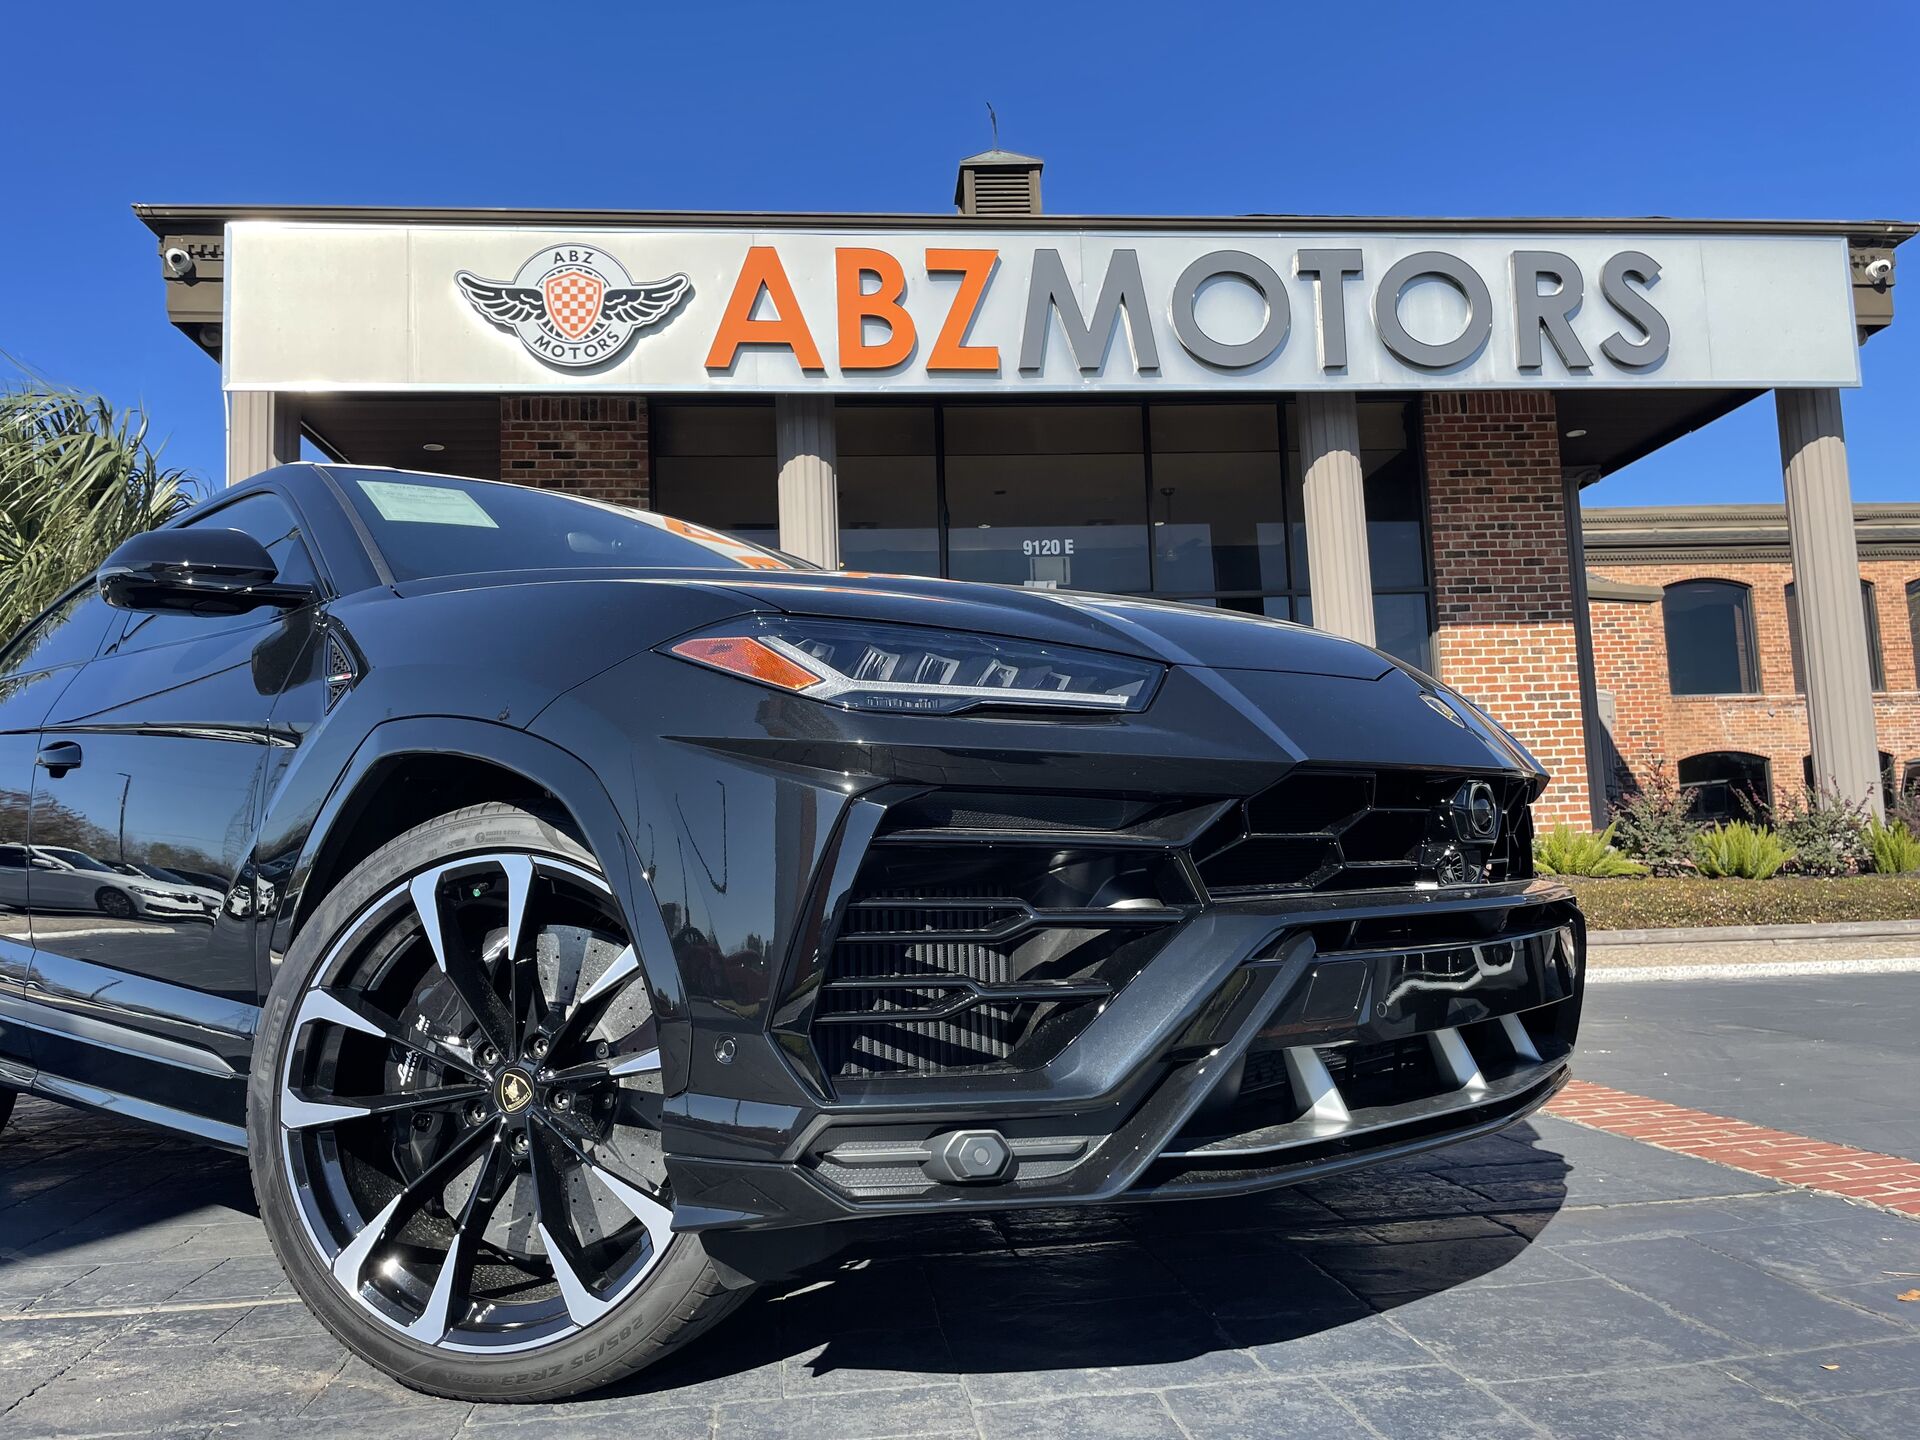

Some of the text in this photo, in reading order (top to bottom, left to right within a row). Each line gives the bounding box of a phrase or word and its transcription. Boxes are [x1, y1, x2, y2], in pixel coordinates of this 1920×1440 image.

[553, 250, 594, 265] ABZ
[533, 330, 621, 360] MOTORS
[1022, 539, 1075, 556] 9120 E
[570, 1313, 645, 1371] 285/35
[500, 1362, 564, 1387] ZR23
